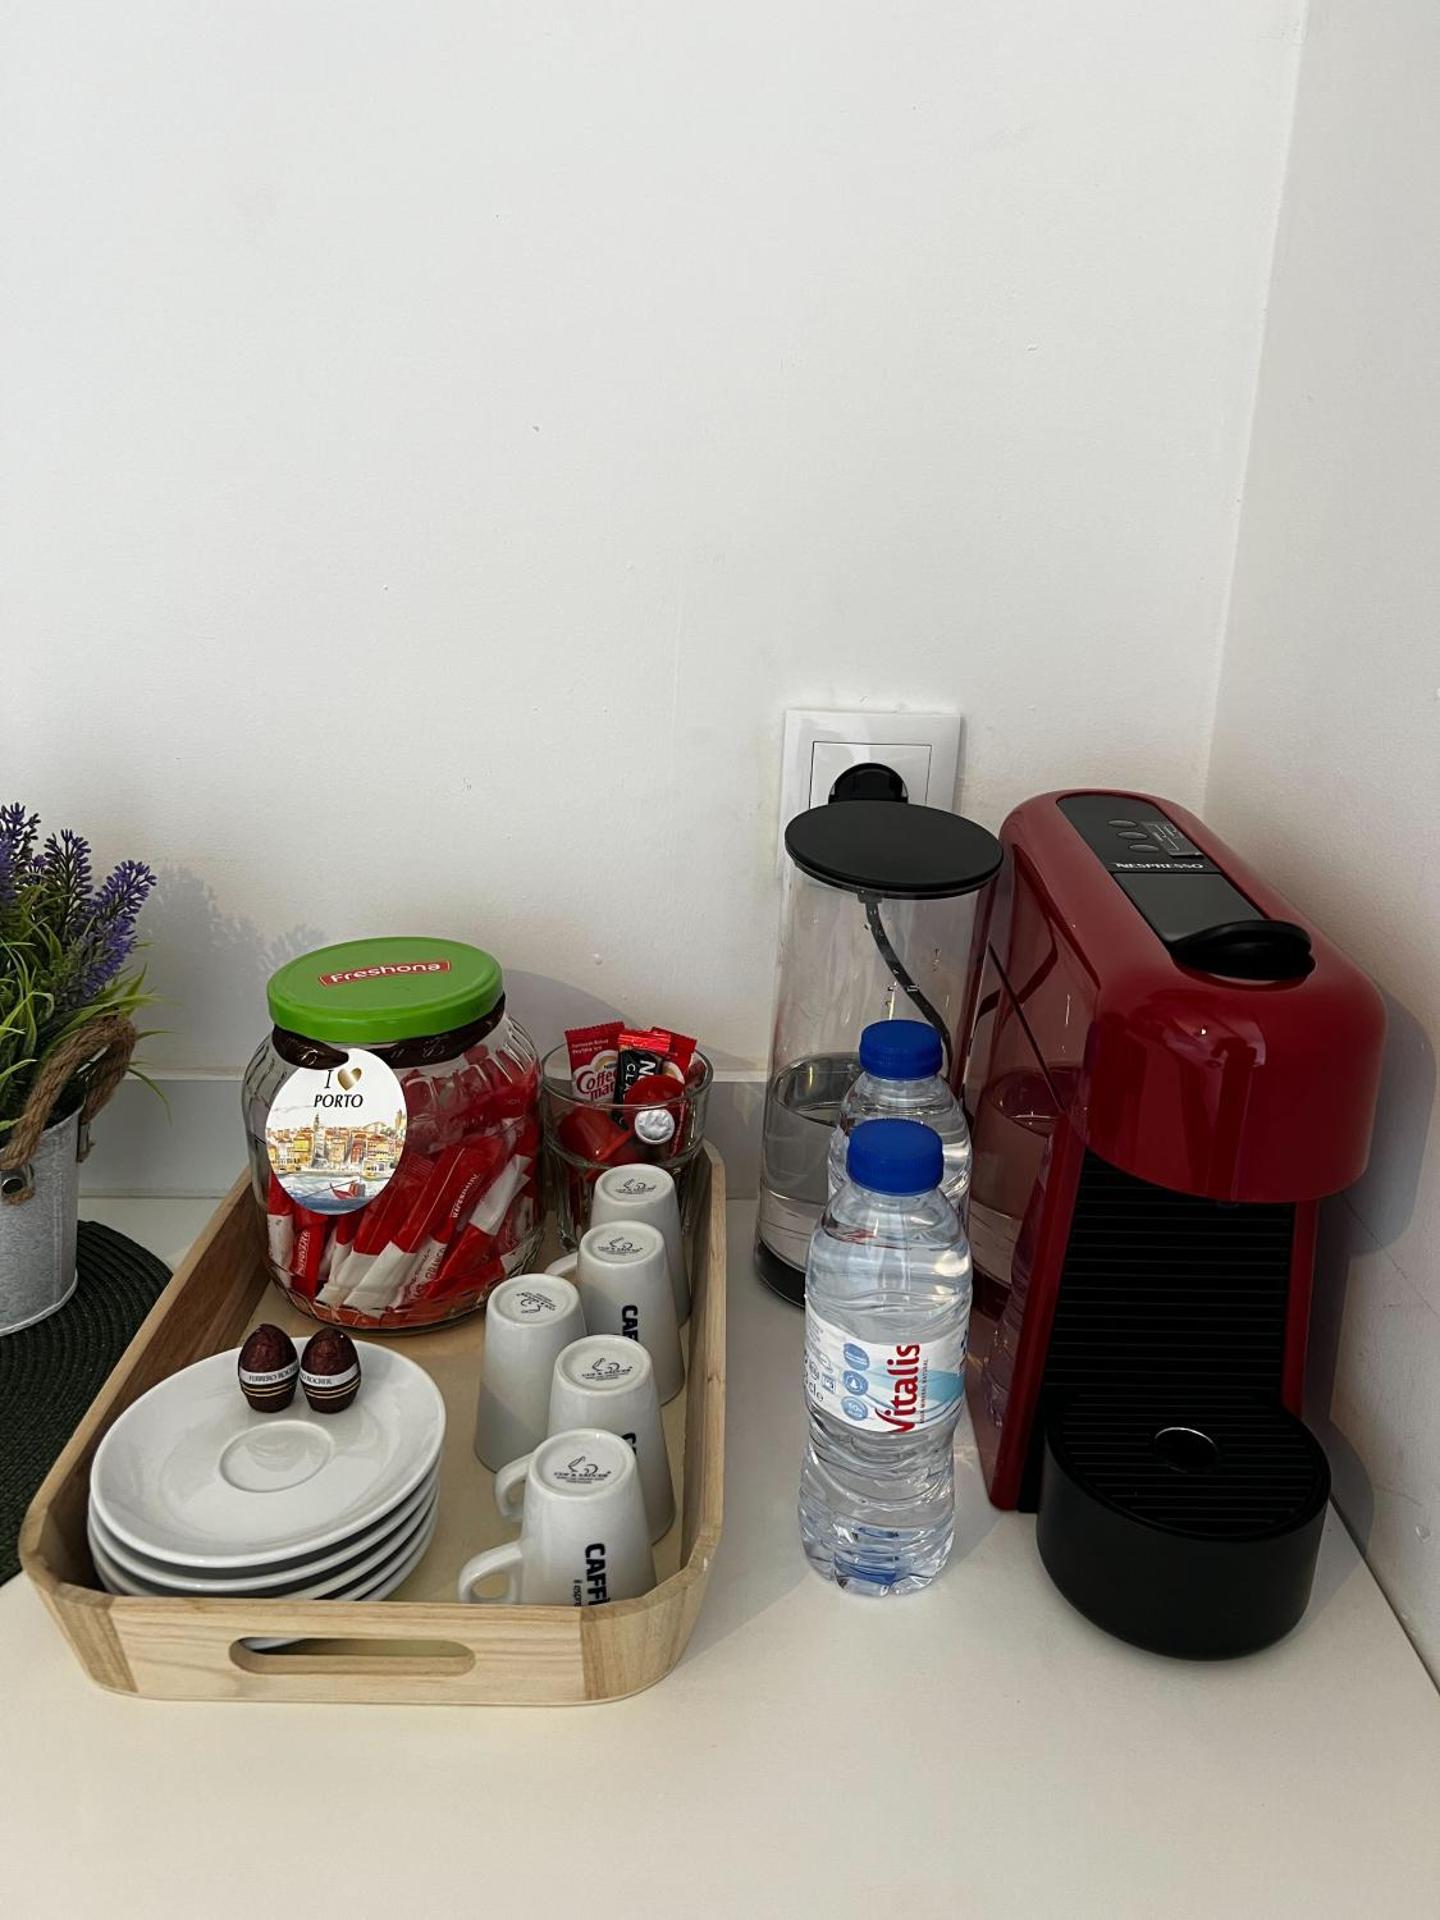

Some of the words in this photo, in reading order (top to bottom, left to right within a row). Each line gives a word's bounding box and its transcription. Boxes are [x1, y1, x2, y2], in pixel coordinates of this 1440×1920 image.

[330, 963, 441, 983] Freshona
[323, 1069, 335, 1089] I
[313, 1093, 365, 1108] PORTO
[621, 1305, 639, 1342] CAF
[876, 1344, 920, 1434] Vitalis
